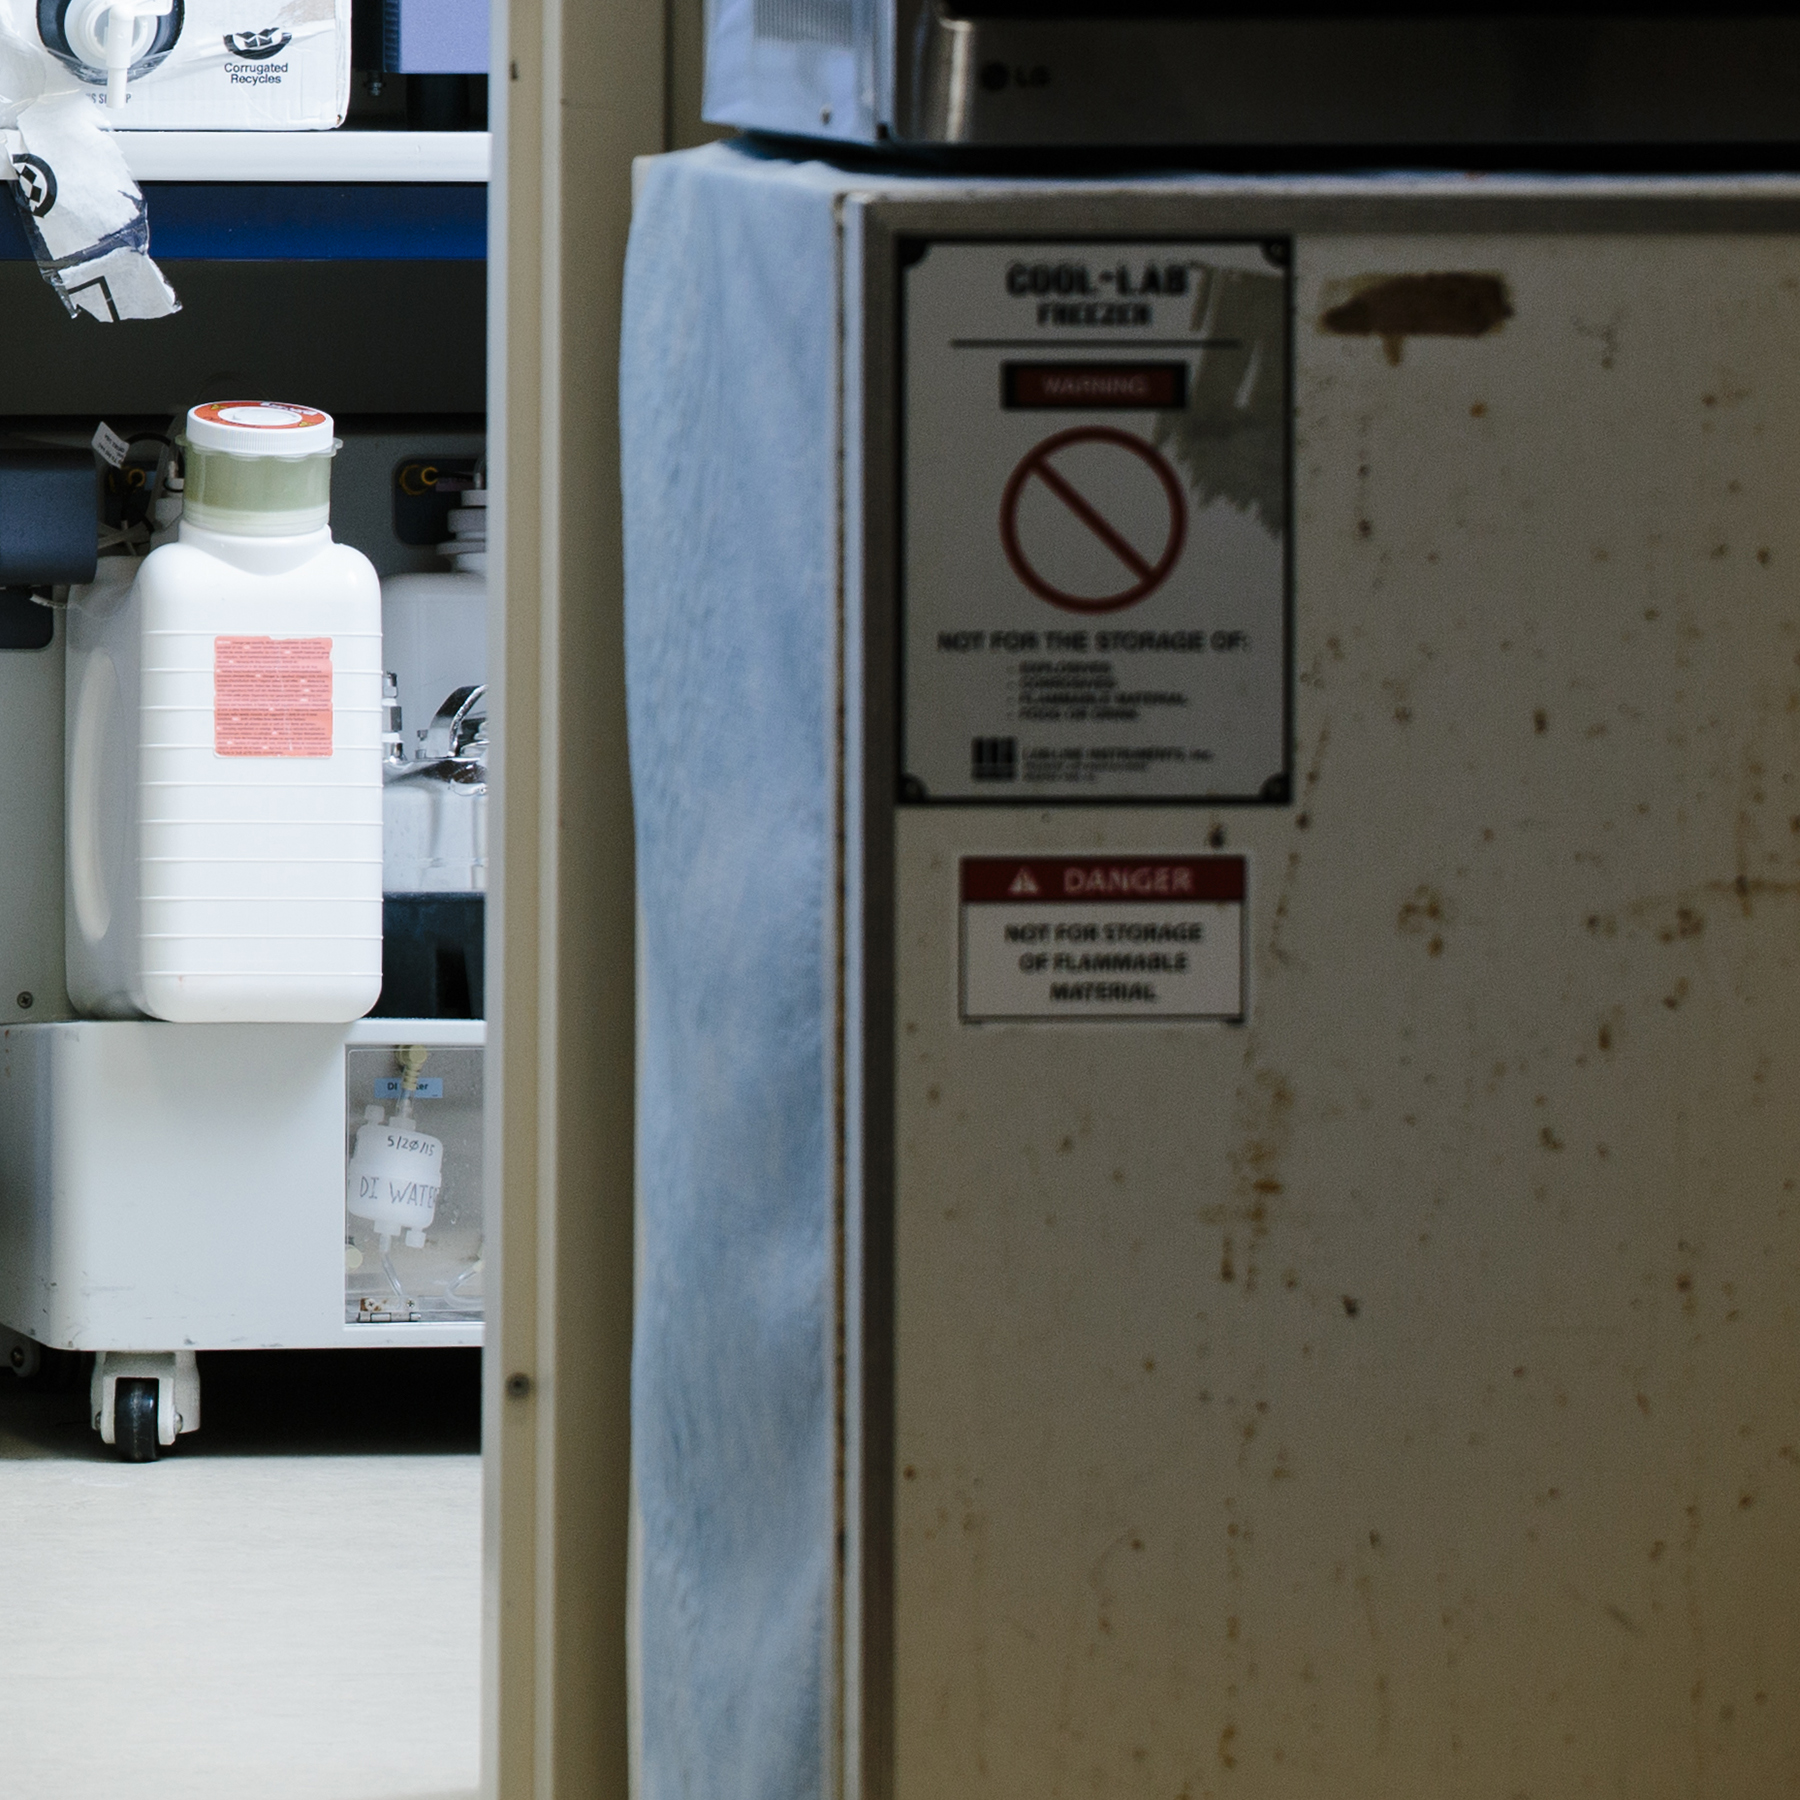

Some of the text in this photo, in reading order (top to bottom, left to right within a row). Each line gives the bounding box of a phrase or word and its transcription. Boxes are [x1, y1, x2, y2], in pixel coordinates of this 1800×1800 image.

[224, 62, 289, 76] Corrugated
[1016, 67, 1050, 89] LG
[230, 73, 282, 87] Recycles
[1005, 261, 1189, 297] COOL-LAB
[1037, 302, 1151, 326] FREEZER
[1041, 375, 1150, 396] WARNING
[937, 630, 1248, 652] NOT FOR THE STORAGE OF:
[1062, 866, 1195, 895] DANGER
[1004, 922, 1203, 942] NOT FOR STORAGE
[1018, 952, 1189, 973] OF FLAMMABLE
[1049, 982, 1157, 1001] MATERIAL
[387, 1082, 398, 1091] DI
[359, 1175, 380, 1200] DI
